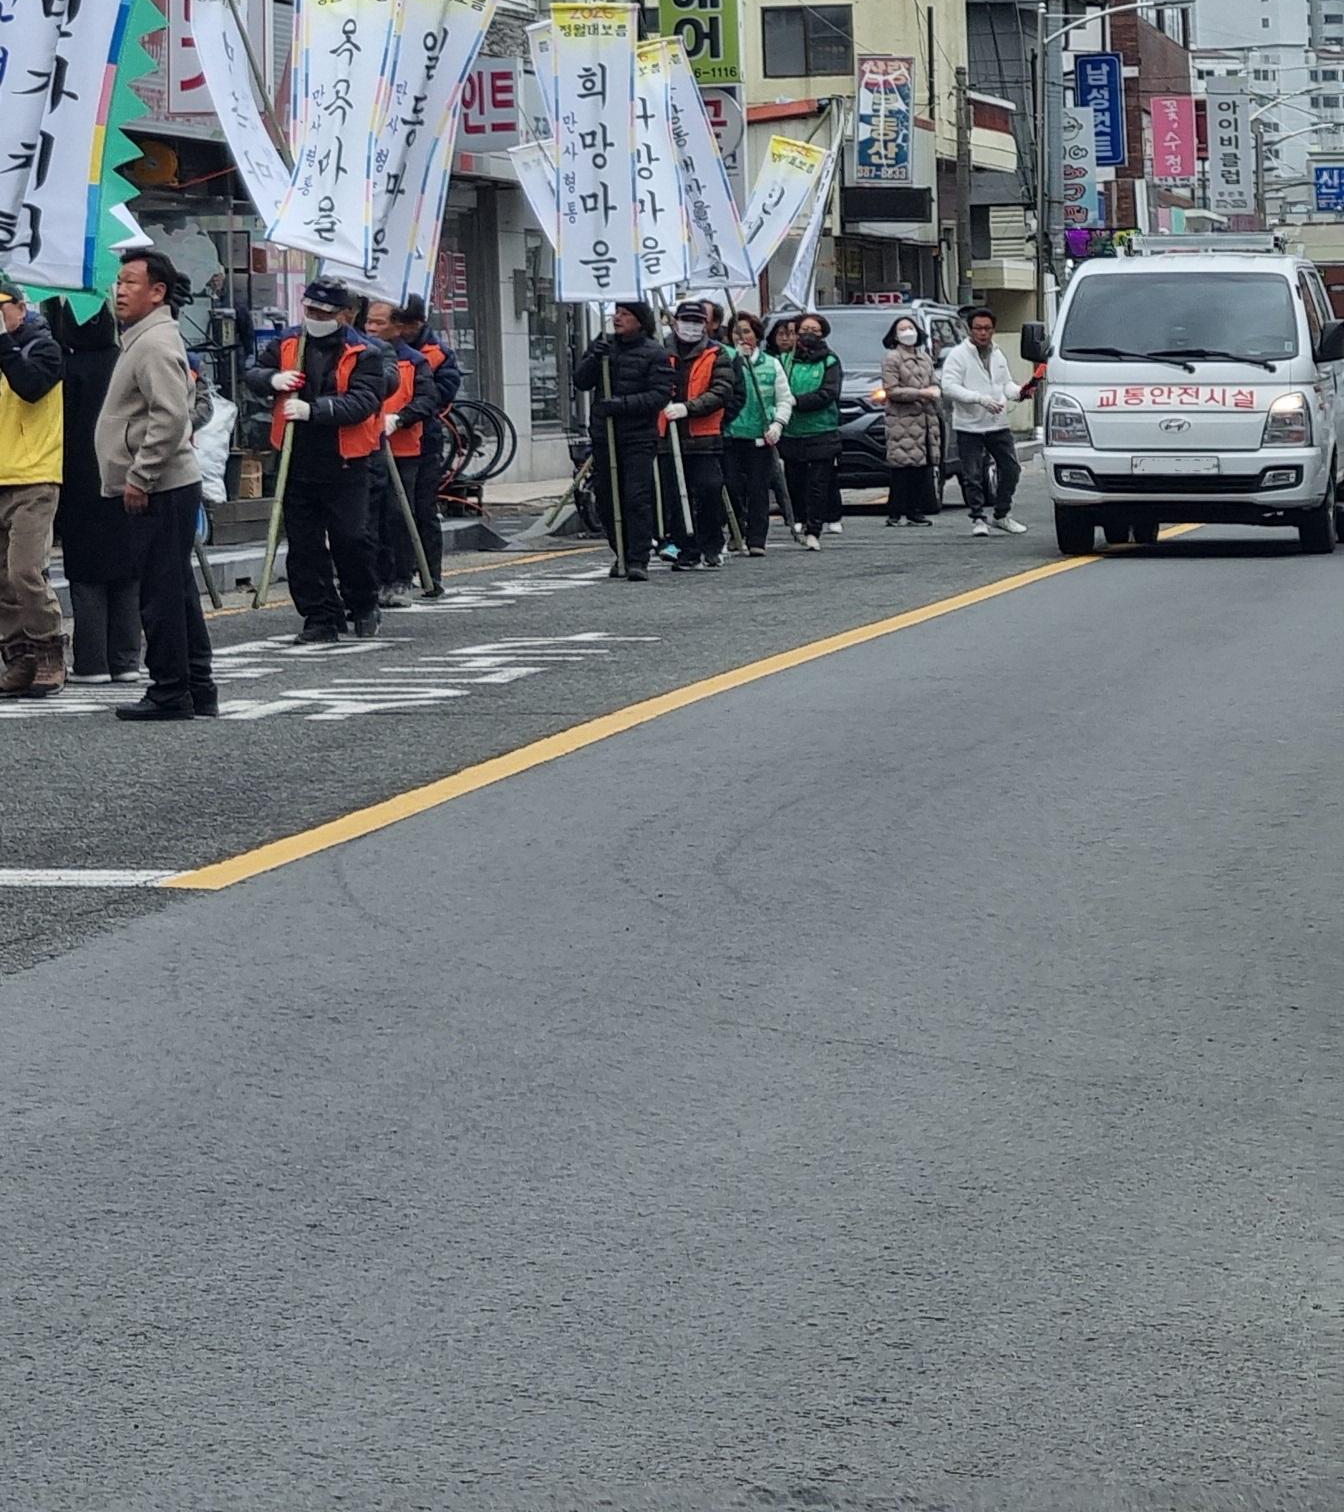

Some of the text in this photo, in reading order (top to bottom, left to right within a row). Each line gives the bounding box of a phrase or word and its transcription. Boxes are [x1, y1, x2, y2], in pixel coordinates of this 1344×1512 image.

[577, 62, 617, 289] 희망마을
[1217, 100, 1241, 185] 아이비클럽
[1096, 385, 1257, 410] 교통안전시설
